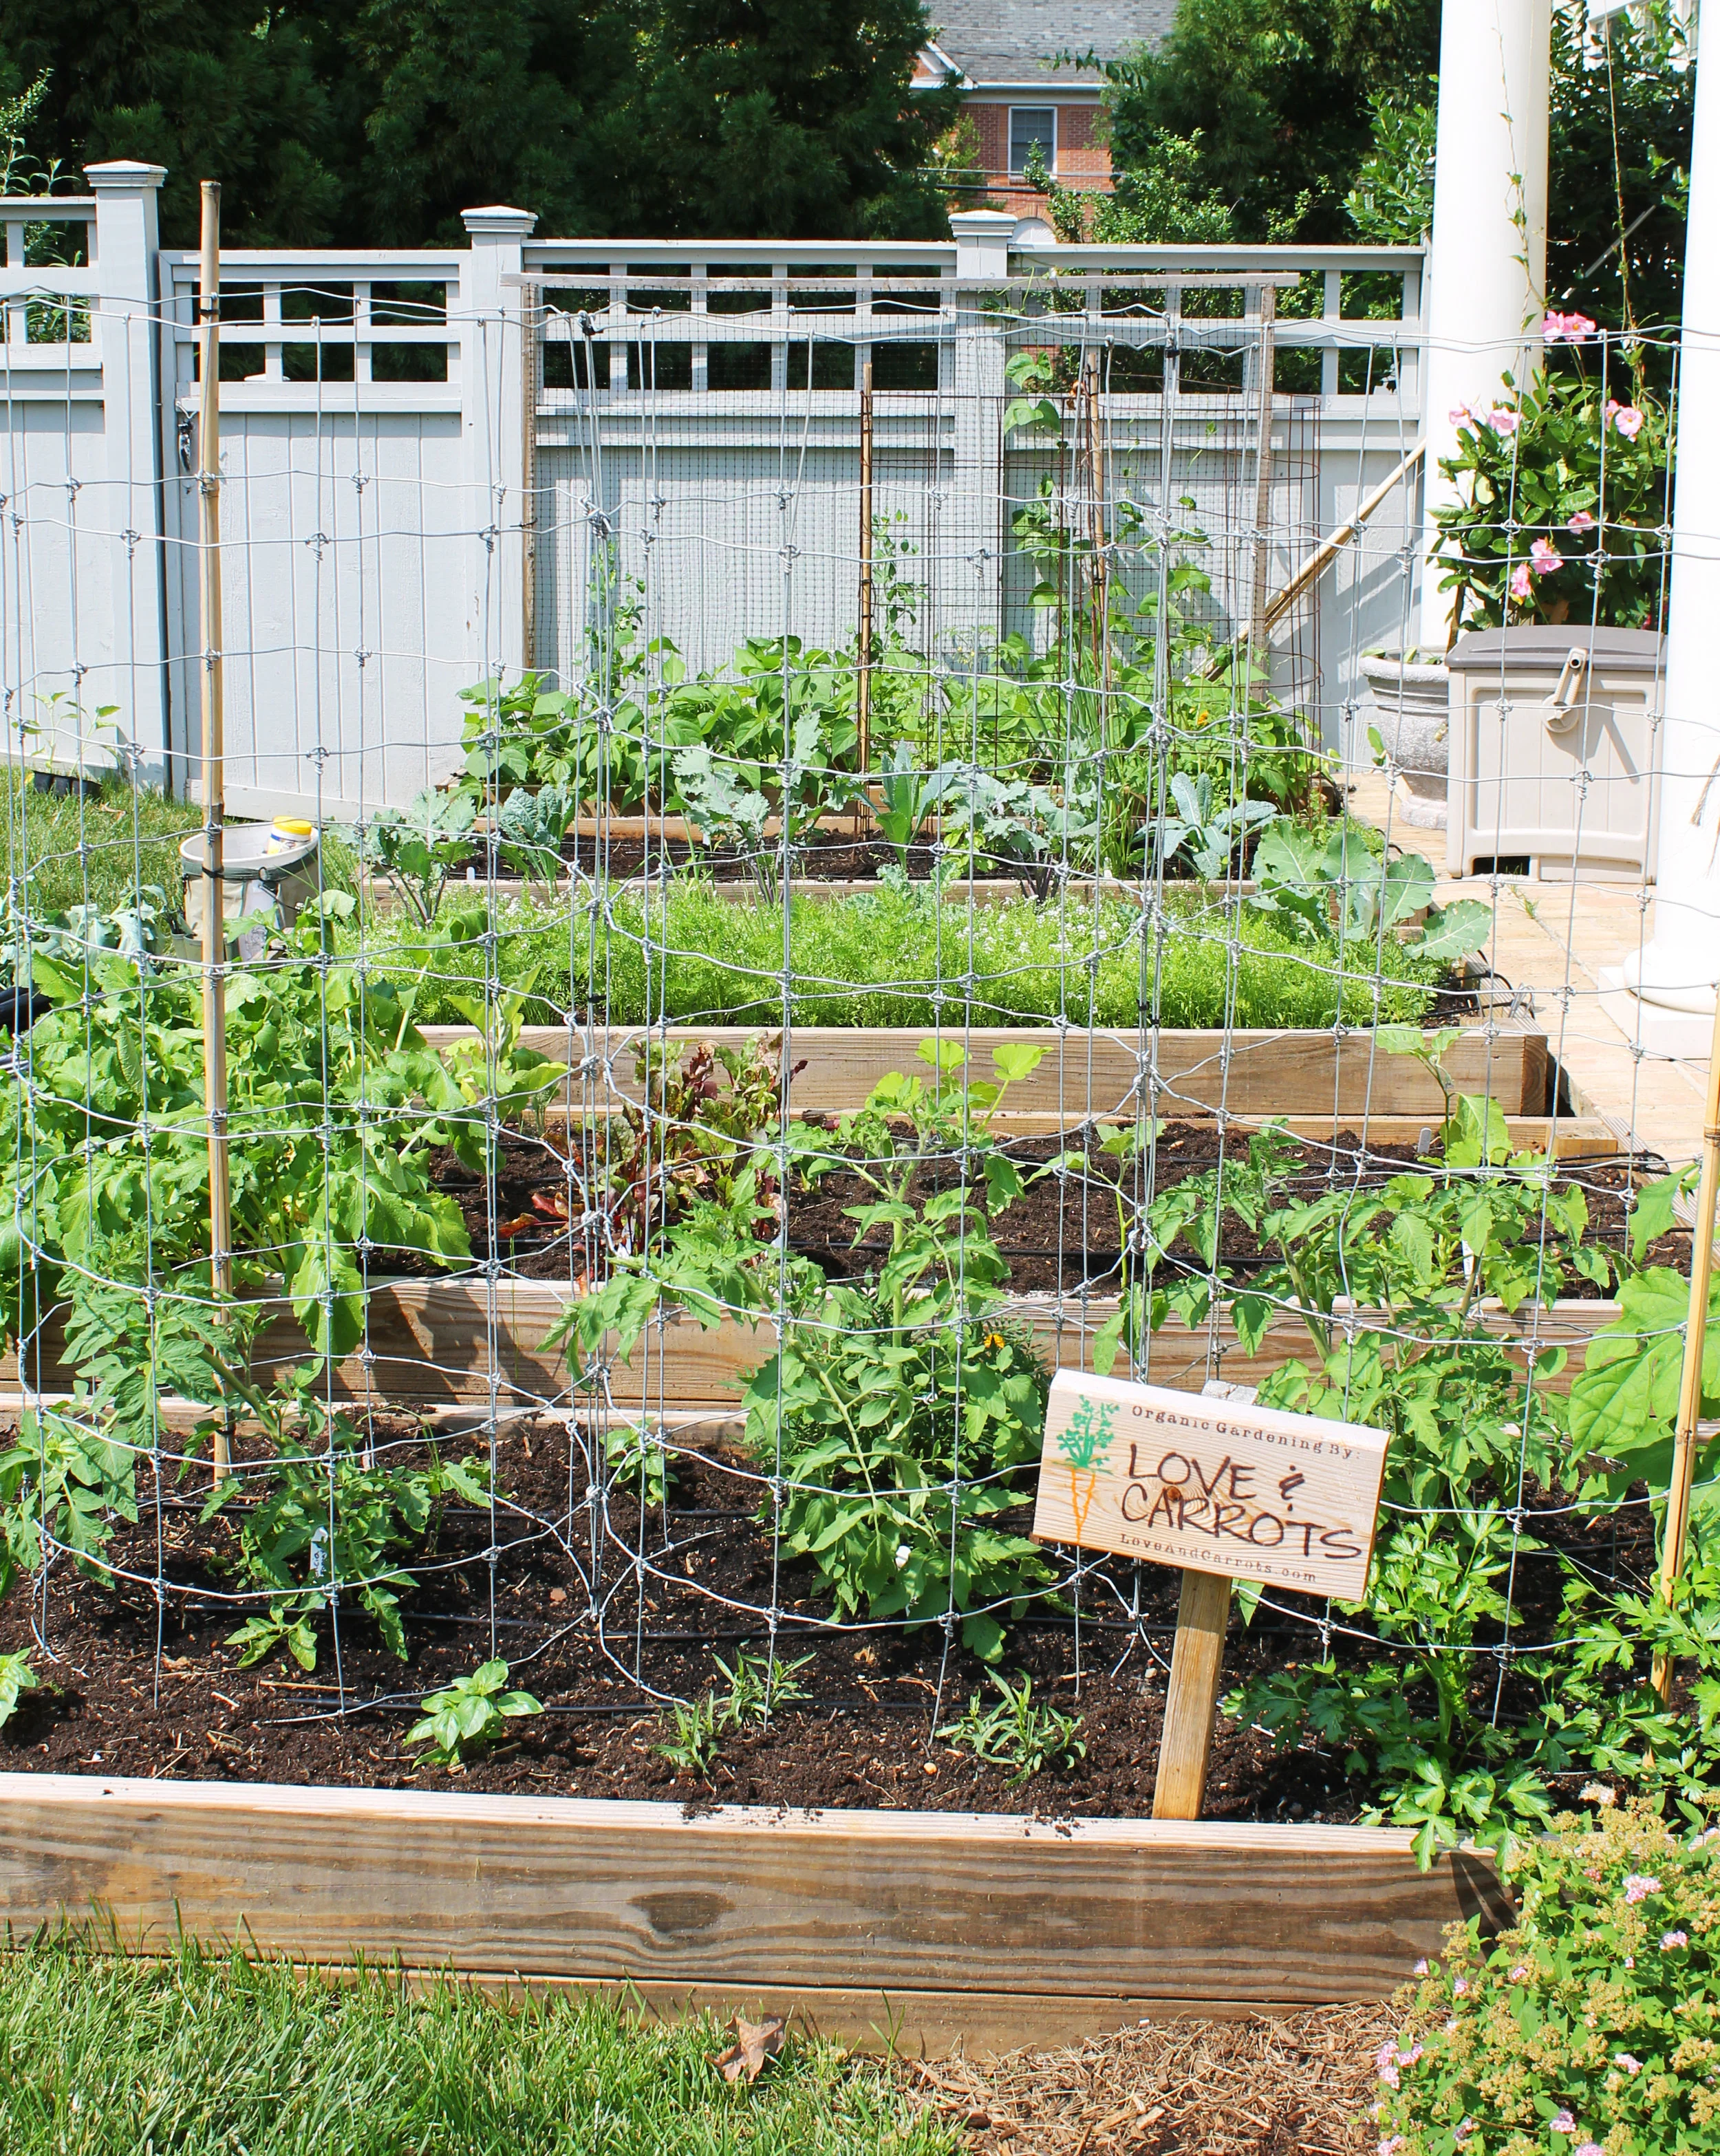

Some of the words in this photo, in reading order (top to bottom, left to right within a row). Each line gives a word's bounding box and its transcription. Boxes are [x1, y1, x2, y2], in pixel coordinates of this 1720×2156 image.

[1132, 1405, 1210, 1430] Organic
[1216, 1422, 1322, 1454] Gardening
[1329, 1443, 1360, 1459] By:
[1129, 1443, 1257, 1499] LOVE
[1278, 1464, 1305, 1511] &
[1121, 1483, 1362, 1559] CARROTS
[1120, 1533, 1316, 1582] LoveAndCarrots.com
